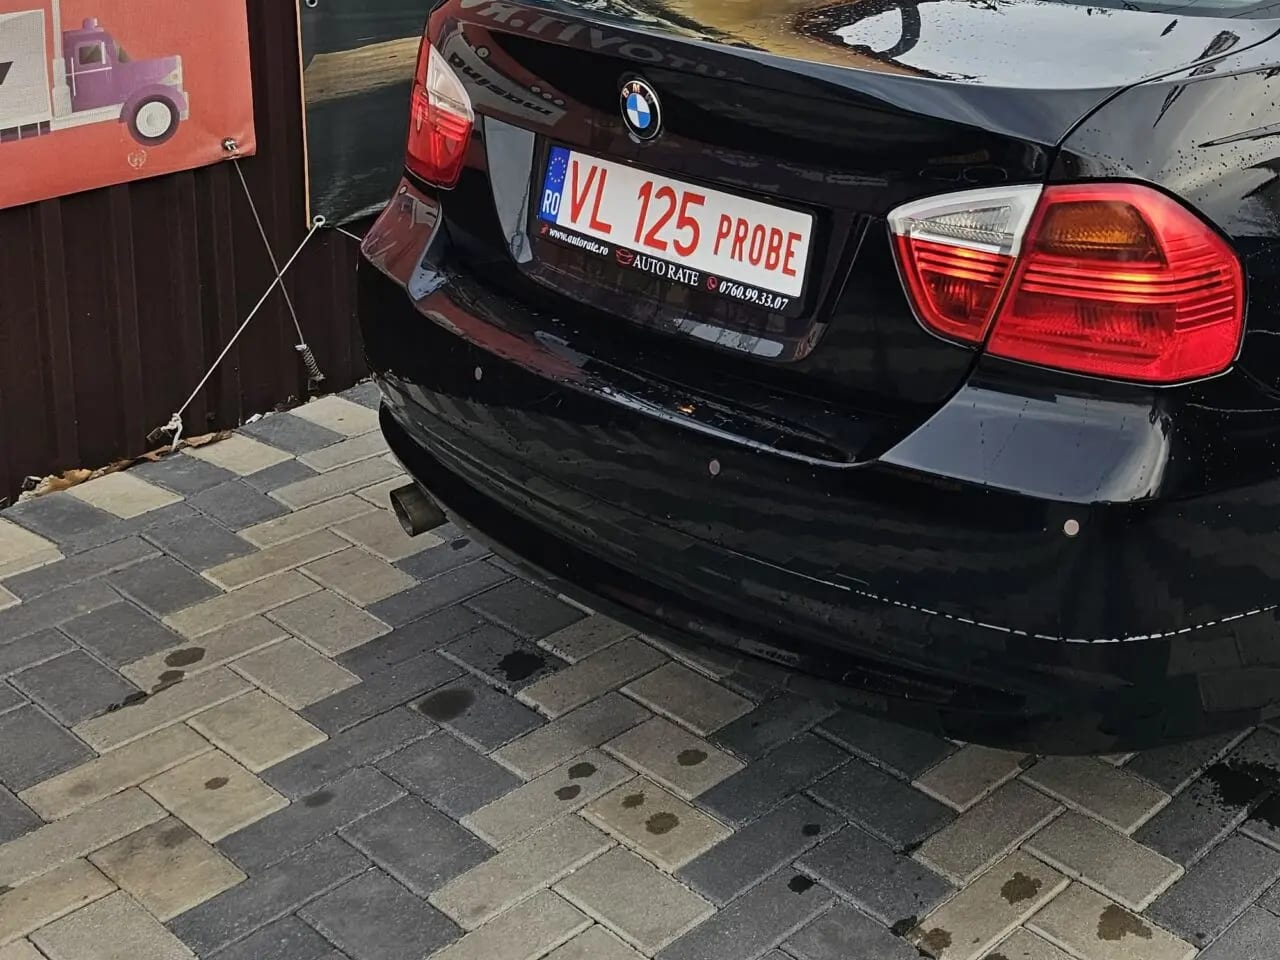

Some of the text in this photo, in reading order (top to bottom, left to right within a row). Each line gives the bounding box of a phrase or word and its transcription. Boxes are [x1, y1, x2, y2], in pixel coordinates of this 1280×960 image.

[542, 189, 560, 216] RO
[570, 159, 803, 277] VL 125 PROBE
[549, 228, 609, 256] www.autorate.ro
[632, 254, 700, 287] AUTO RATE
[719, 280, 789, 311] 0760.99.33.07
